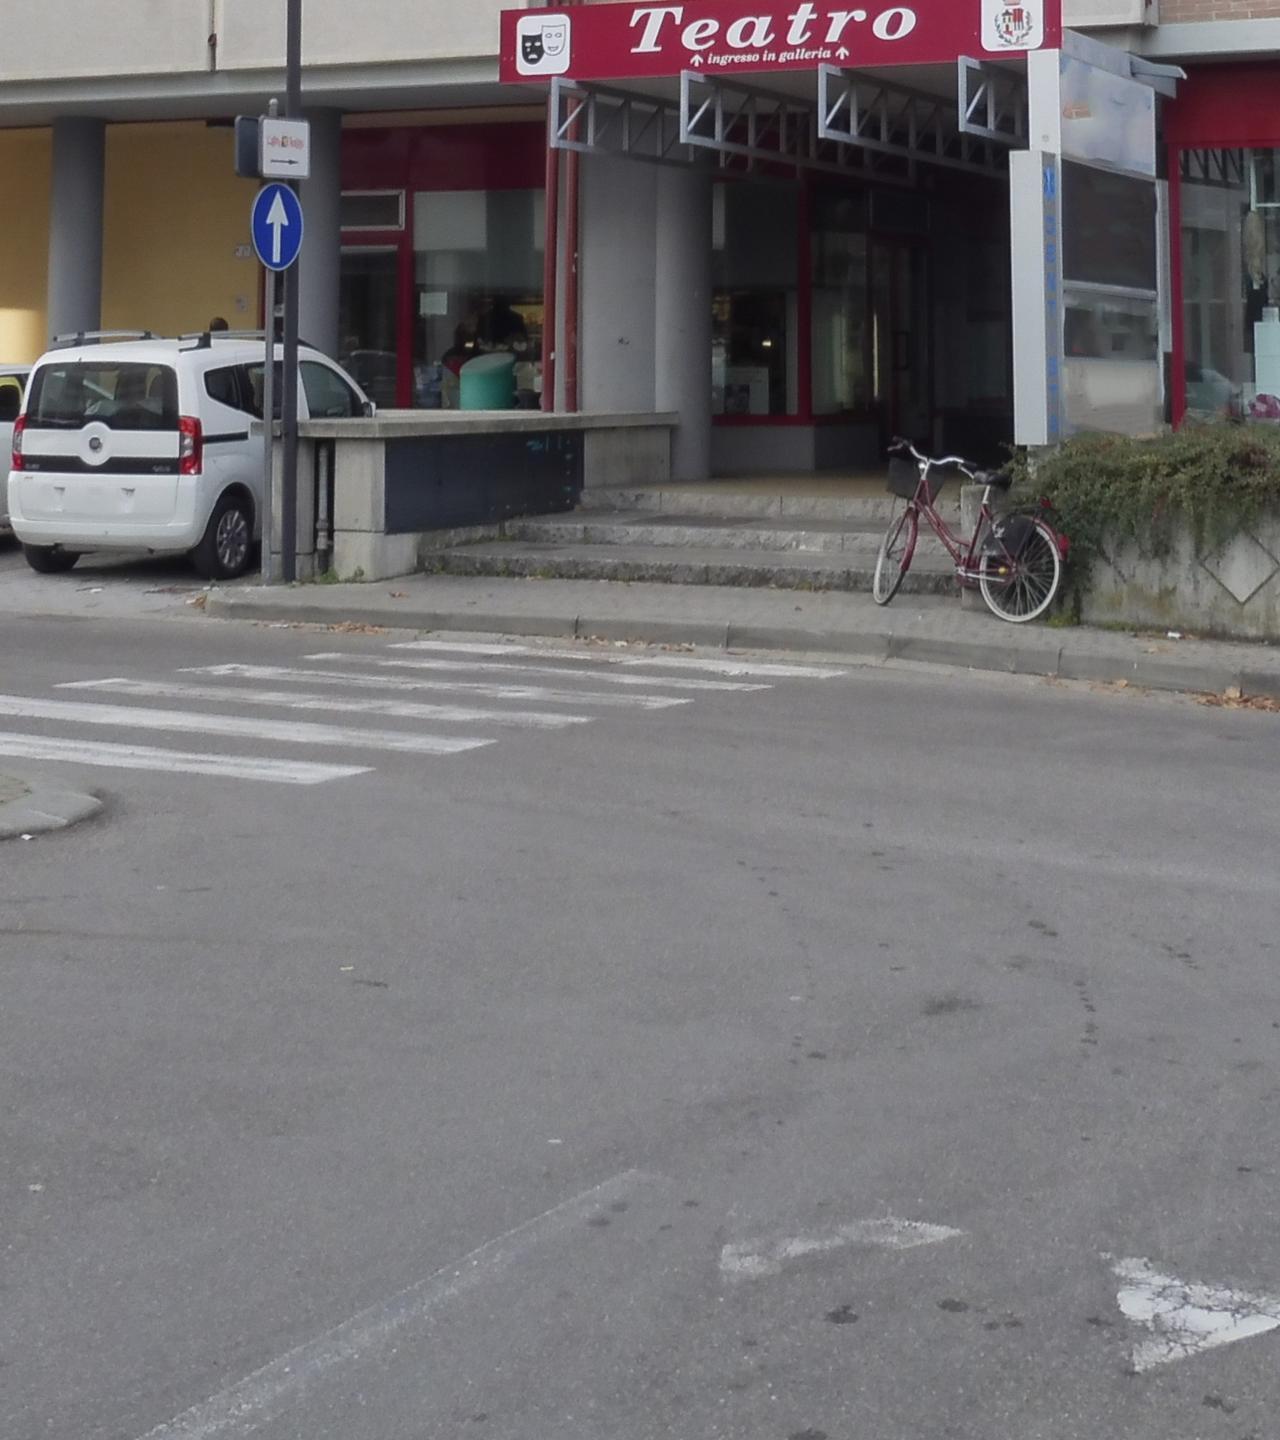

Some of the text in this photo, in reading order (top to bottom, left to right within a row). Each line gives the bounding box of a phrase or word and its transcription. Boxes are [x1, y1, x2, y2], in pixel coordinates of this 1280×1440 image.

[628, 2, 917, 54] Teatro
[707, 47, 832, 66] ingresso in galleria
